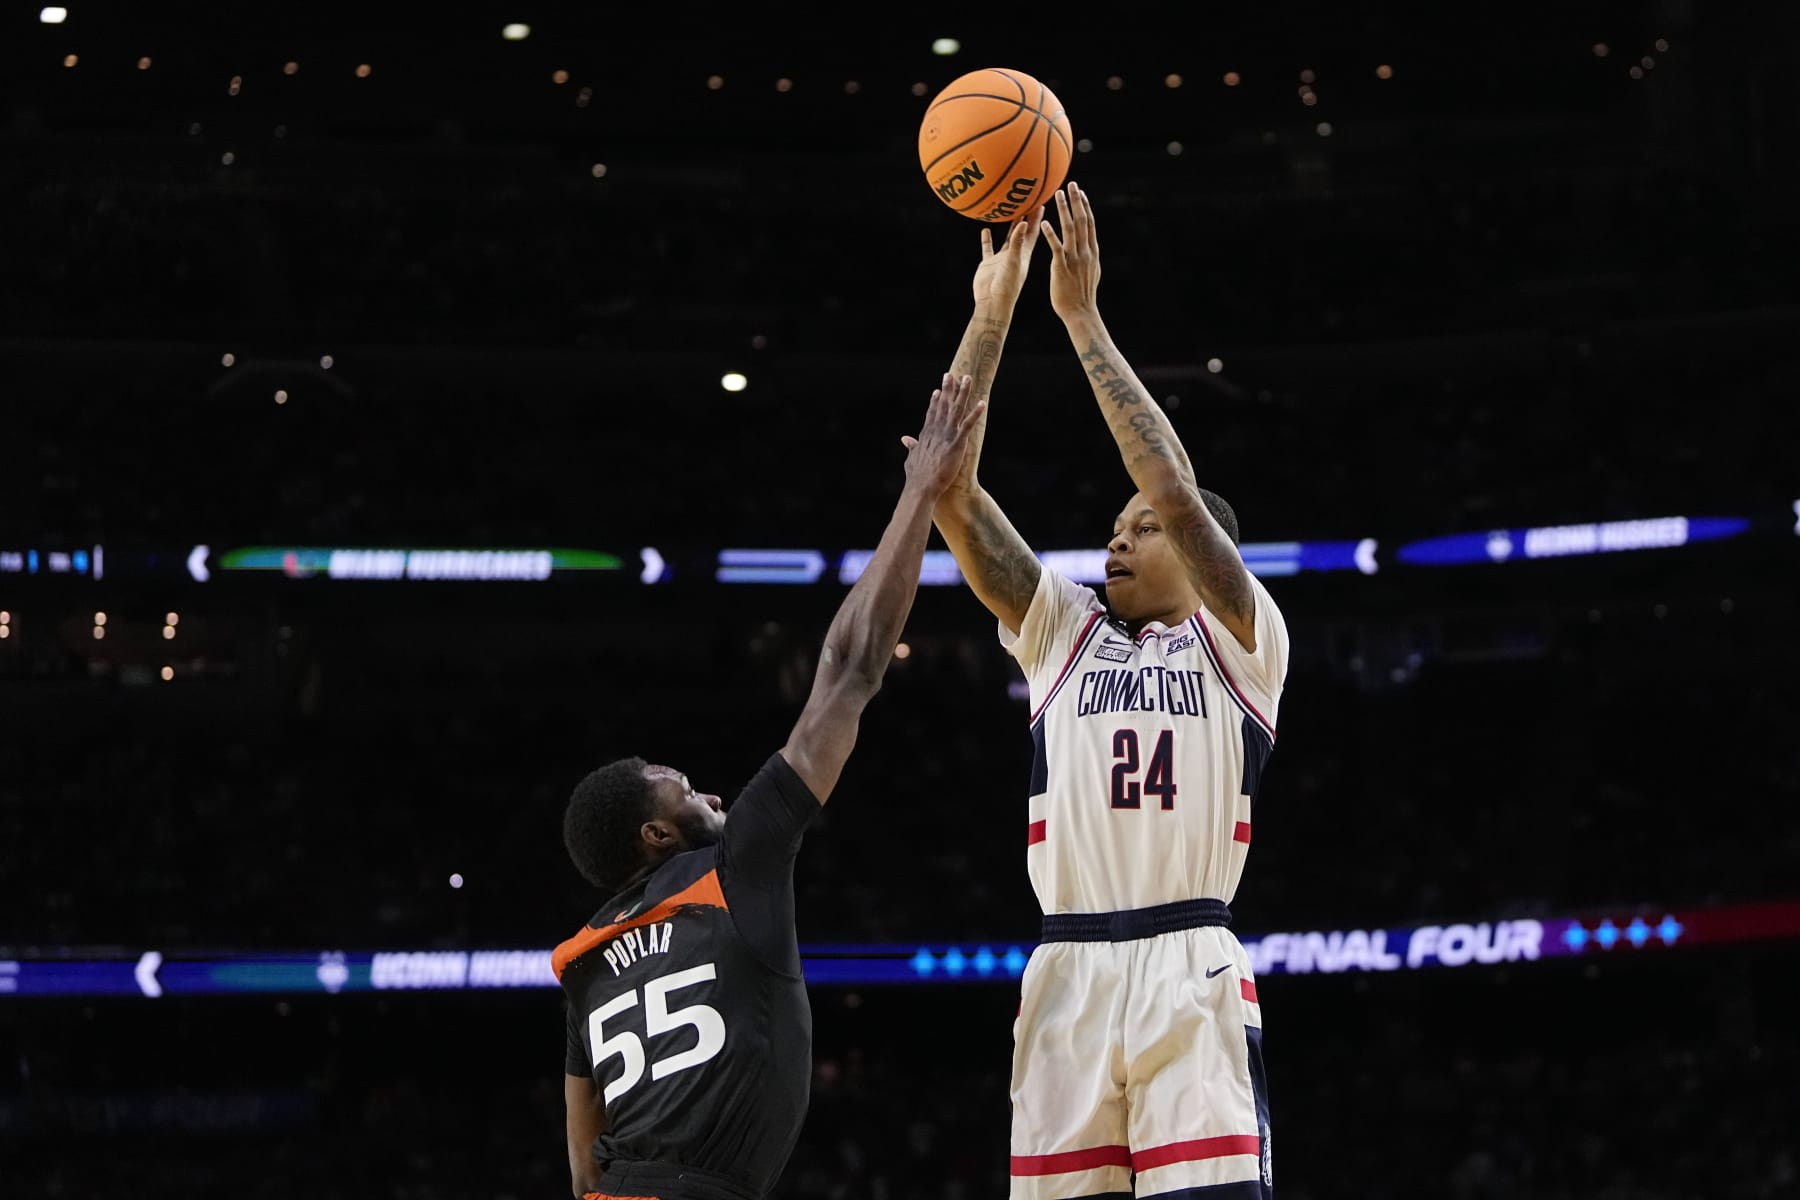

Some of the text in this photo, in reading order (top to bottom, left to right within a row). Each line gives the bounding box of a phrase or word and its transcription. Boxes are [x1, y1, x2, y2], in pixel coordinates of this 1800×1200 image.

[1167, 637, 1196, 653] EAST
[1168, 634, 1189, 648] BIG
[1110, 728, 1178, 811] 24
[603, 922, 673, 977] POPLAR
[1406, 918, 1543, 969] FOUR
[588, 962, 726, 1109] 55
